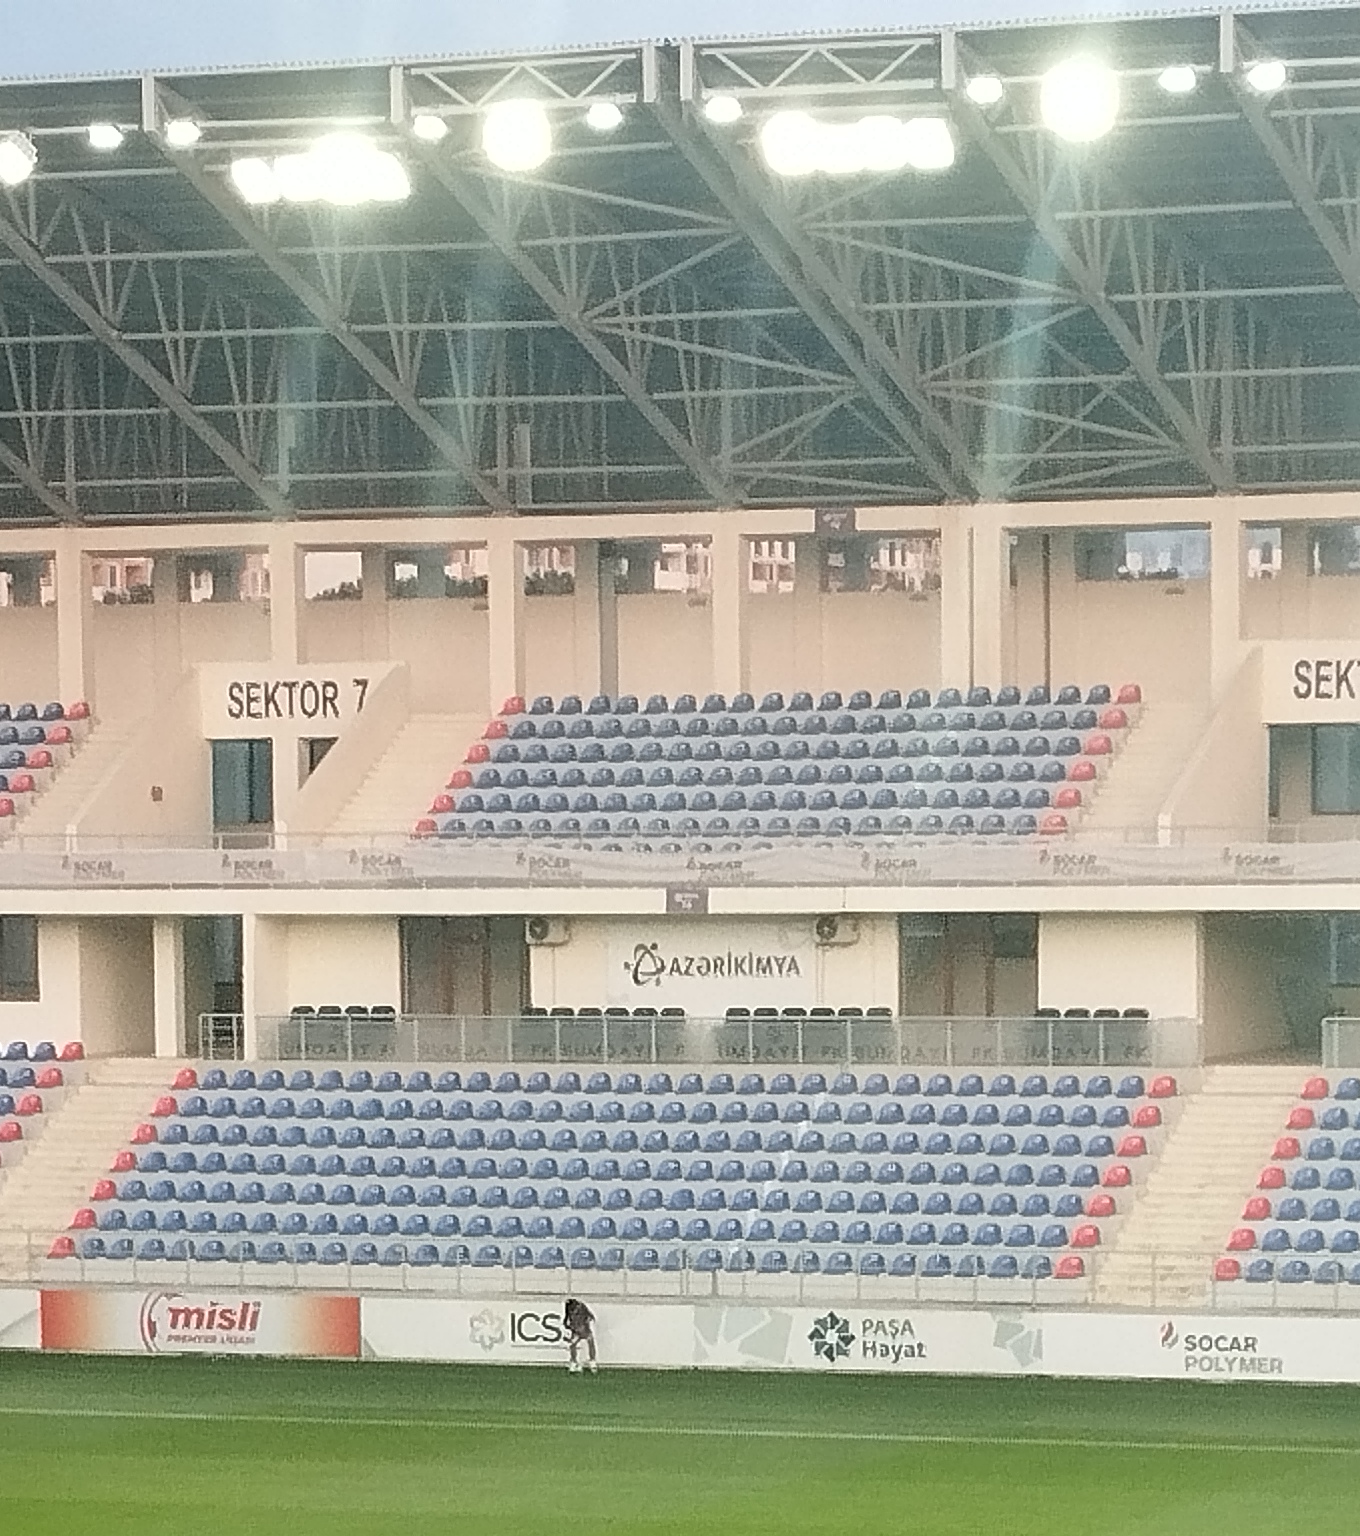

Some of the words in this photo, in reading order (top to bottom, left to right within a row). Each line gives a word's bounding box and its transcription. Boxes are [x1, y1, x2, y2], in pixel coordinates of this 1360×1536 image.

[227, 680, 340, 719] SEKTOR
[352, 677, 369, 713] 7
[168, 1300, 262, 1332] misli
[862, 1318, 916, 1339] PAŞA
[1184, 1335, 1258, 1352] SOCAR
[1184, 1355, 1283, 1374] POLYMER
